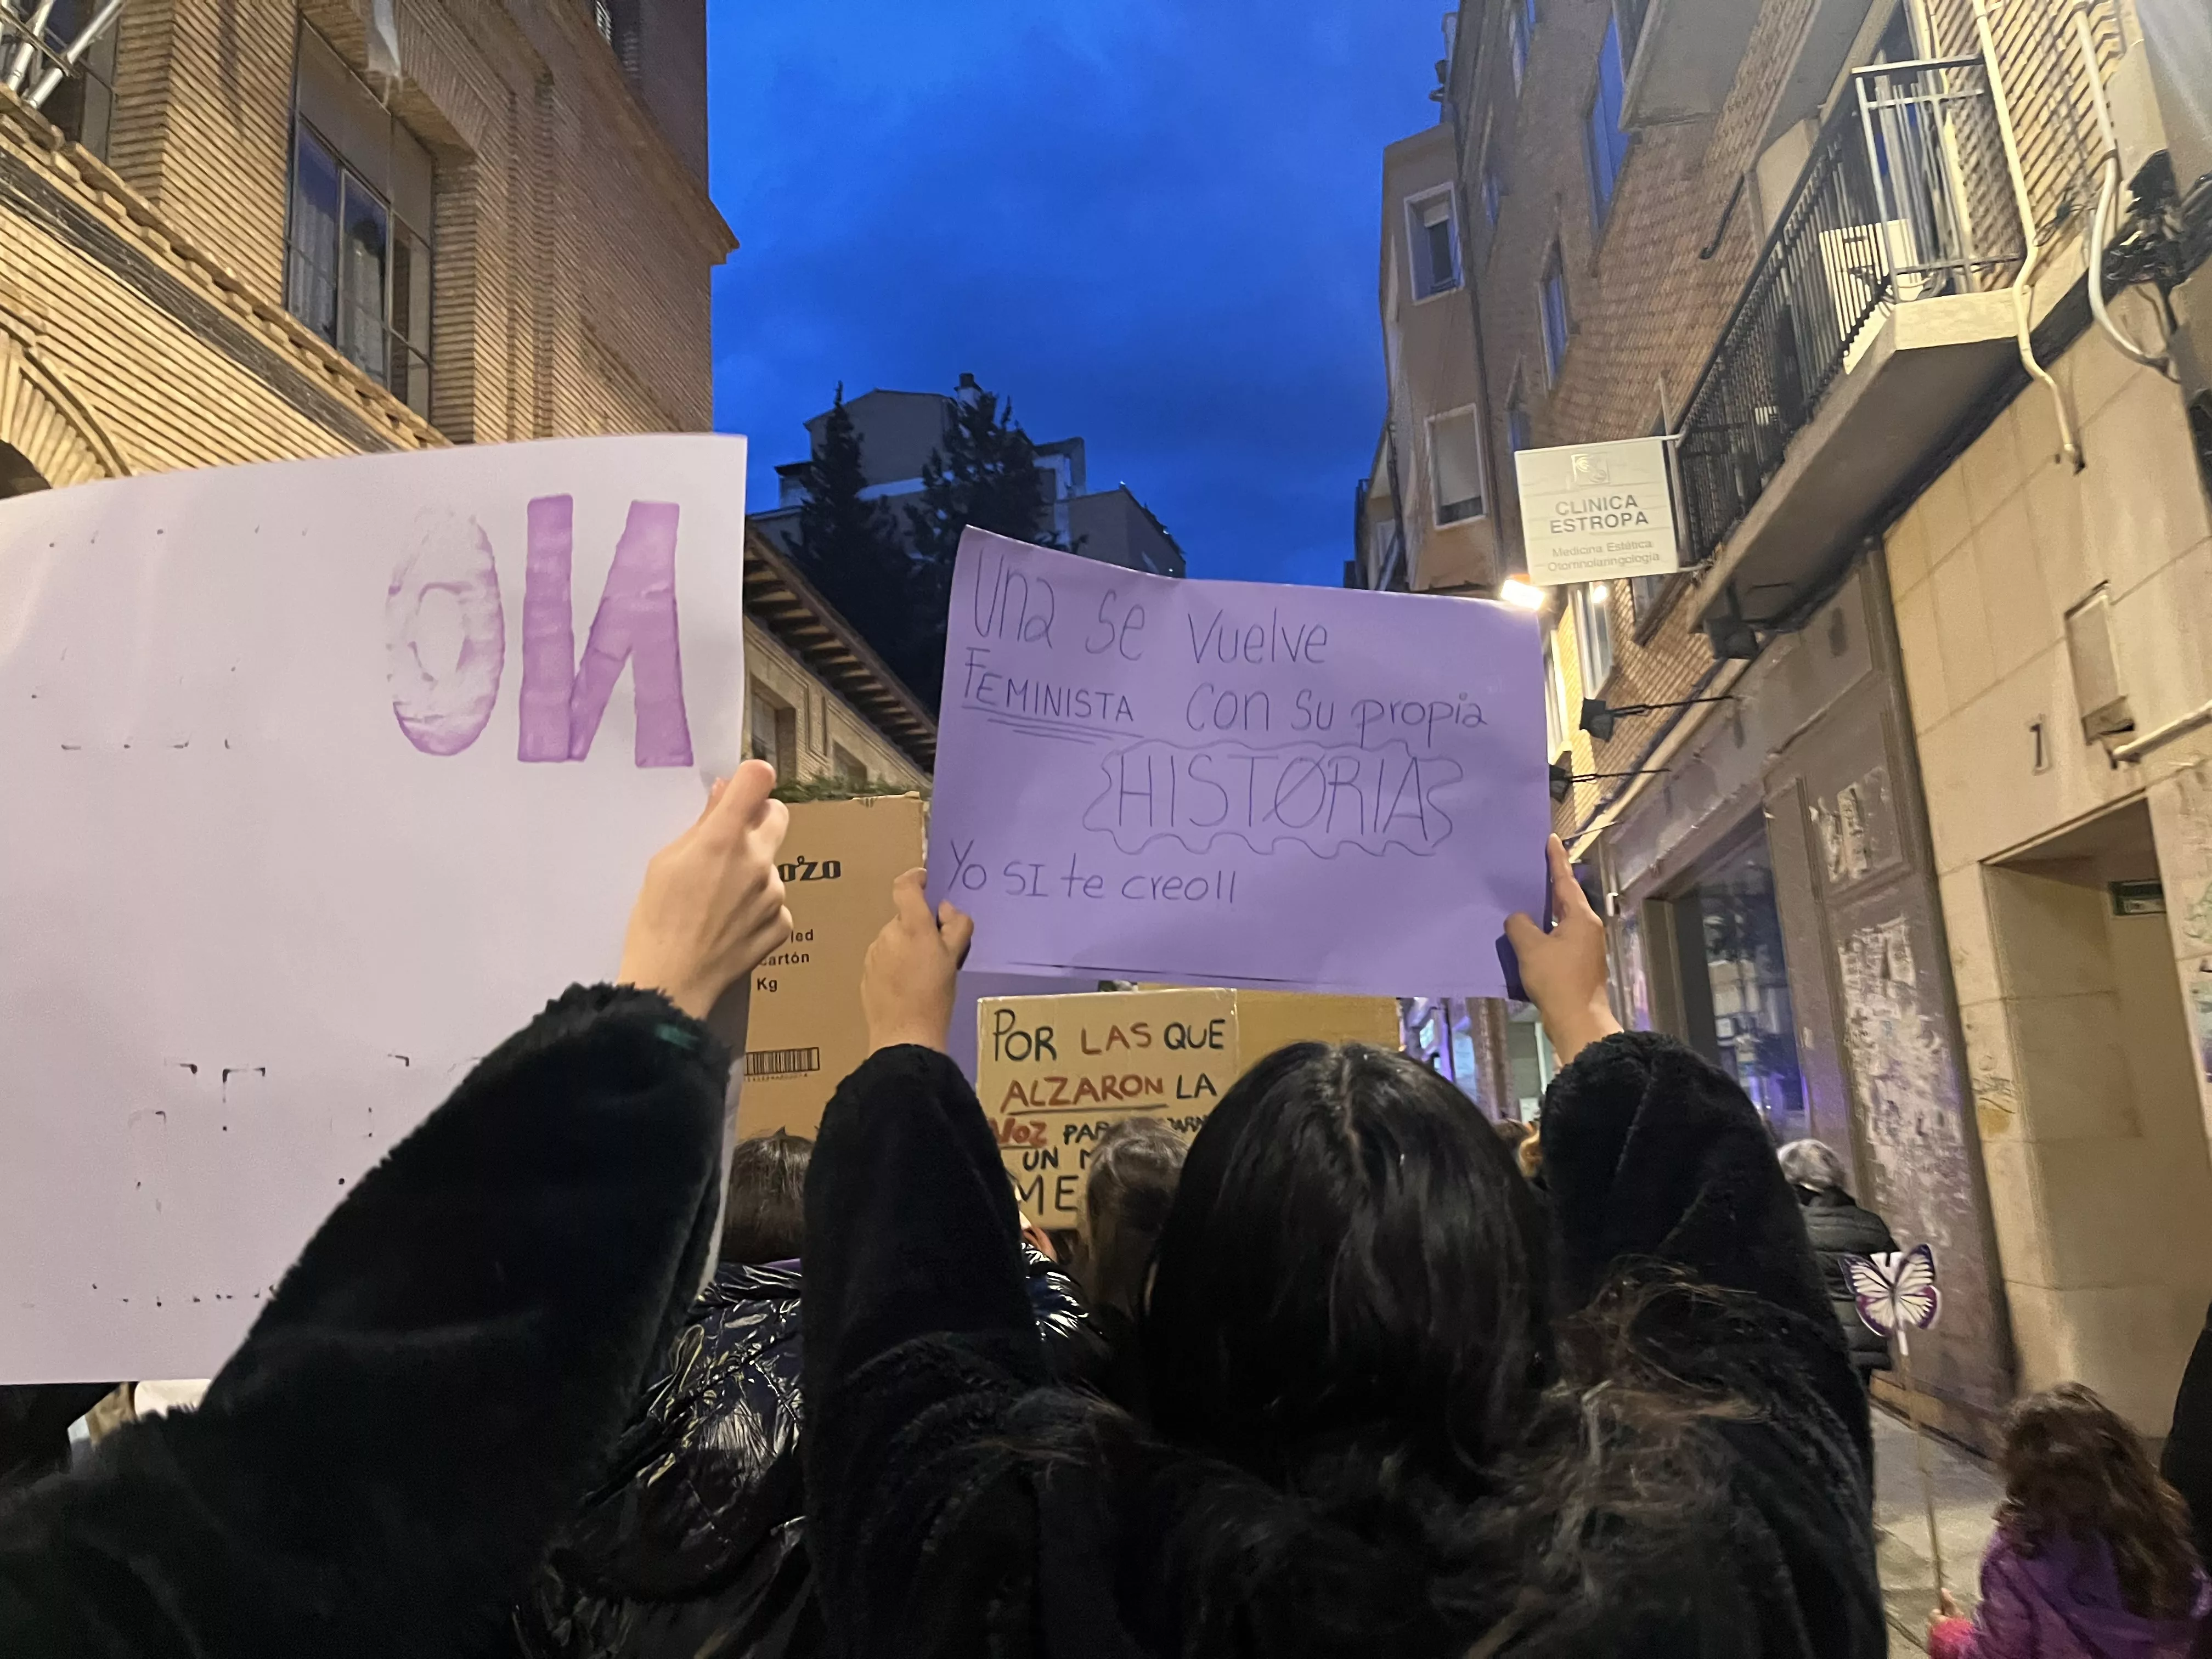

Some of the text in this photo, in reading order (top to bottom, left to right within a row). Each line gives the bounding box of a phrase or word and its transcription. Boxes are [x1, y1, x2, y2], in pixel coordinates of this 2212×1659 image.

[1550, 511, 1649, 534] ESTROPA
[1551, 544, 1602, 557] Medicina
[974, 548, 1054, 650] Una
[964, 646, 1134, 723] FEMINISTA
[1351, 692, 1488, 749] propia
[1060, 853, 1105, 899] te
[757, 977, 777, 992] Kg
[992, 1008, 1226, 1062] POR LAS QUE
[1000, 1073, 1218, 1114] ALZARON LA
[1022, 1145, 1059, 1171] UN
